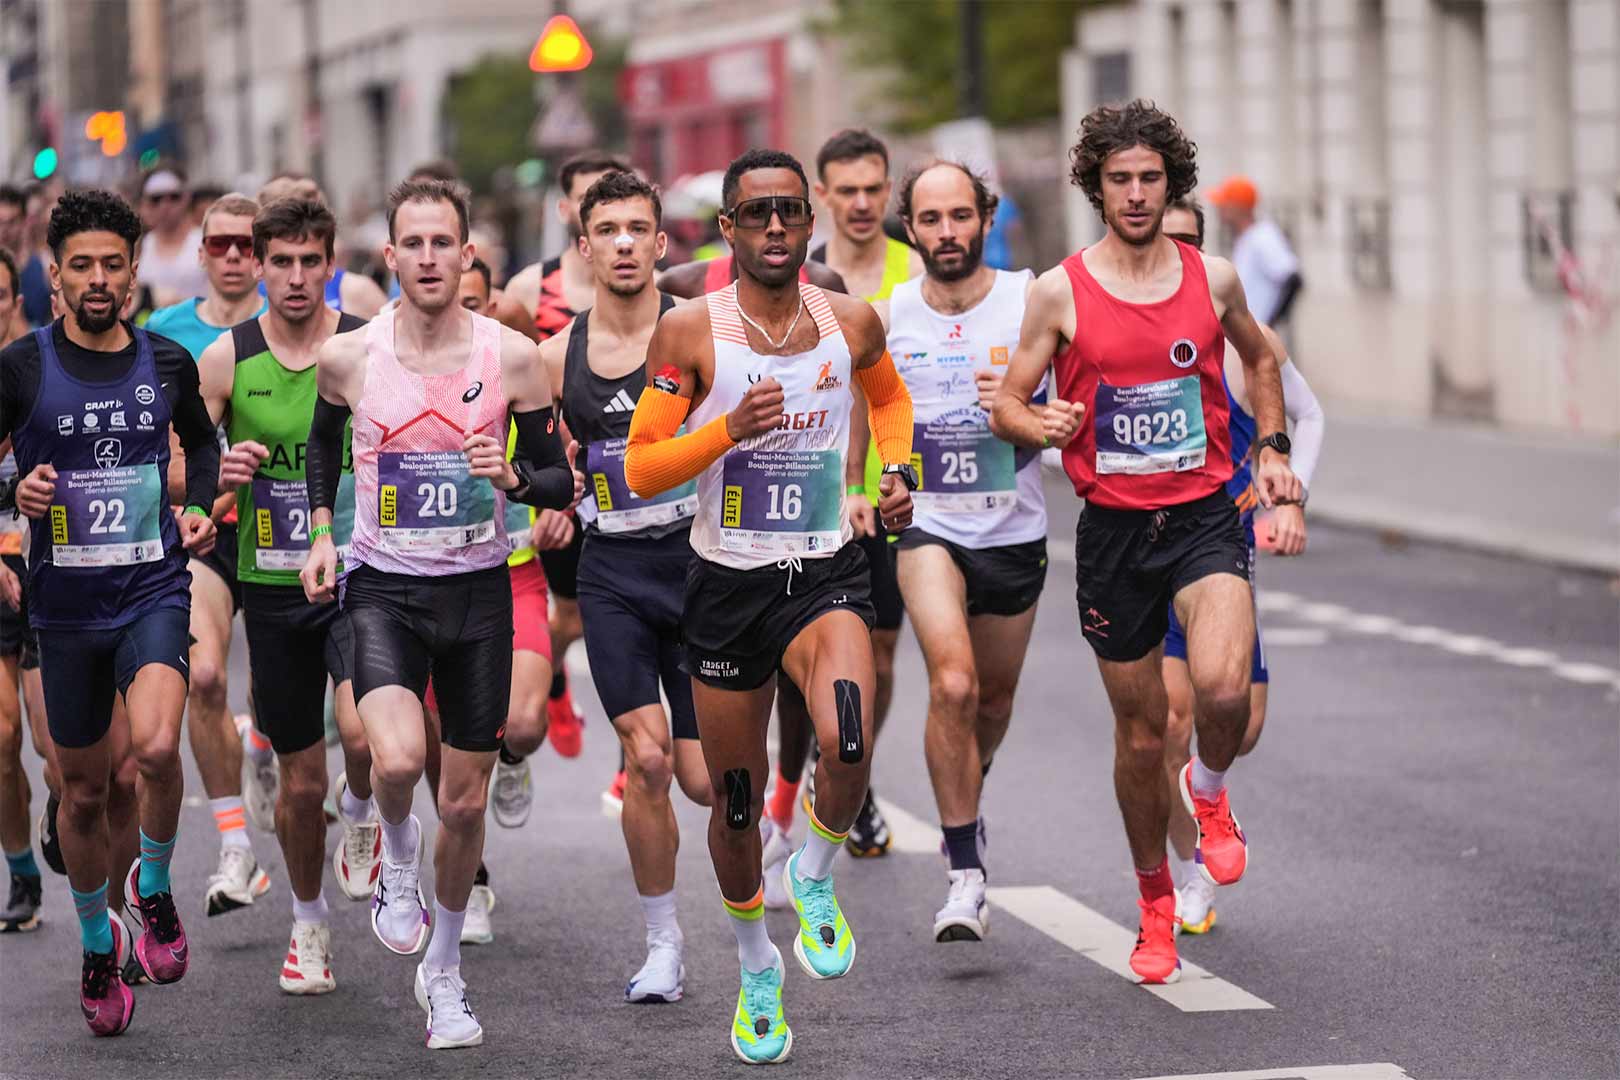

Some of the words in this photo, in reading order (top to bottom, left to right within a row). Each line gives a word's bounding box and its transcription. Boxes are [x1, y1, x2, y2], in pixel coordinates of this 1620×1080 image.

[85, 400, 115, 410] CRAFT
[776, 410, 829, 430] RGET
[1112, 408, 1189, 445] 9623
[403, 452, 459, 461] Semi-Marathon
[747, 460, 825, 471] Boulogne-Billancourt
[752, 452, 809, 461] Semi-Marathon
[810, 452, 820, 460] de
[940, 451, 978, 484] 25
[68, 477, 142, 488] Boulogne-Billancourt
[71, 469, 127, 480] Semi-Marathon
[127, 467, 137, 476] de
[382, 489, 394, 521] ÉLITE
[417, 482, 457, 517] 20
[725, 491, 740, 523] ÉLITE
[766, 484, 802, 520] 16
[52, 510, 64, 540] ÉLITE
[88, 499, 126, 534] 22
[260, 512, 271, 542] ÉLITE
[288, 508, 311, 541] 2
[702, 660, 730, 670] TARGET
[846, 742, 857, 751] KT
